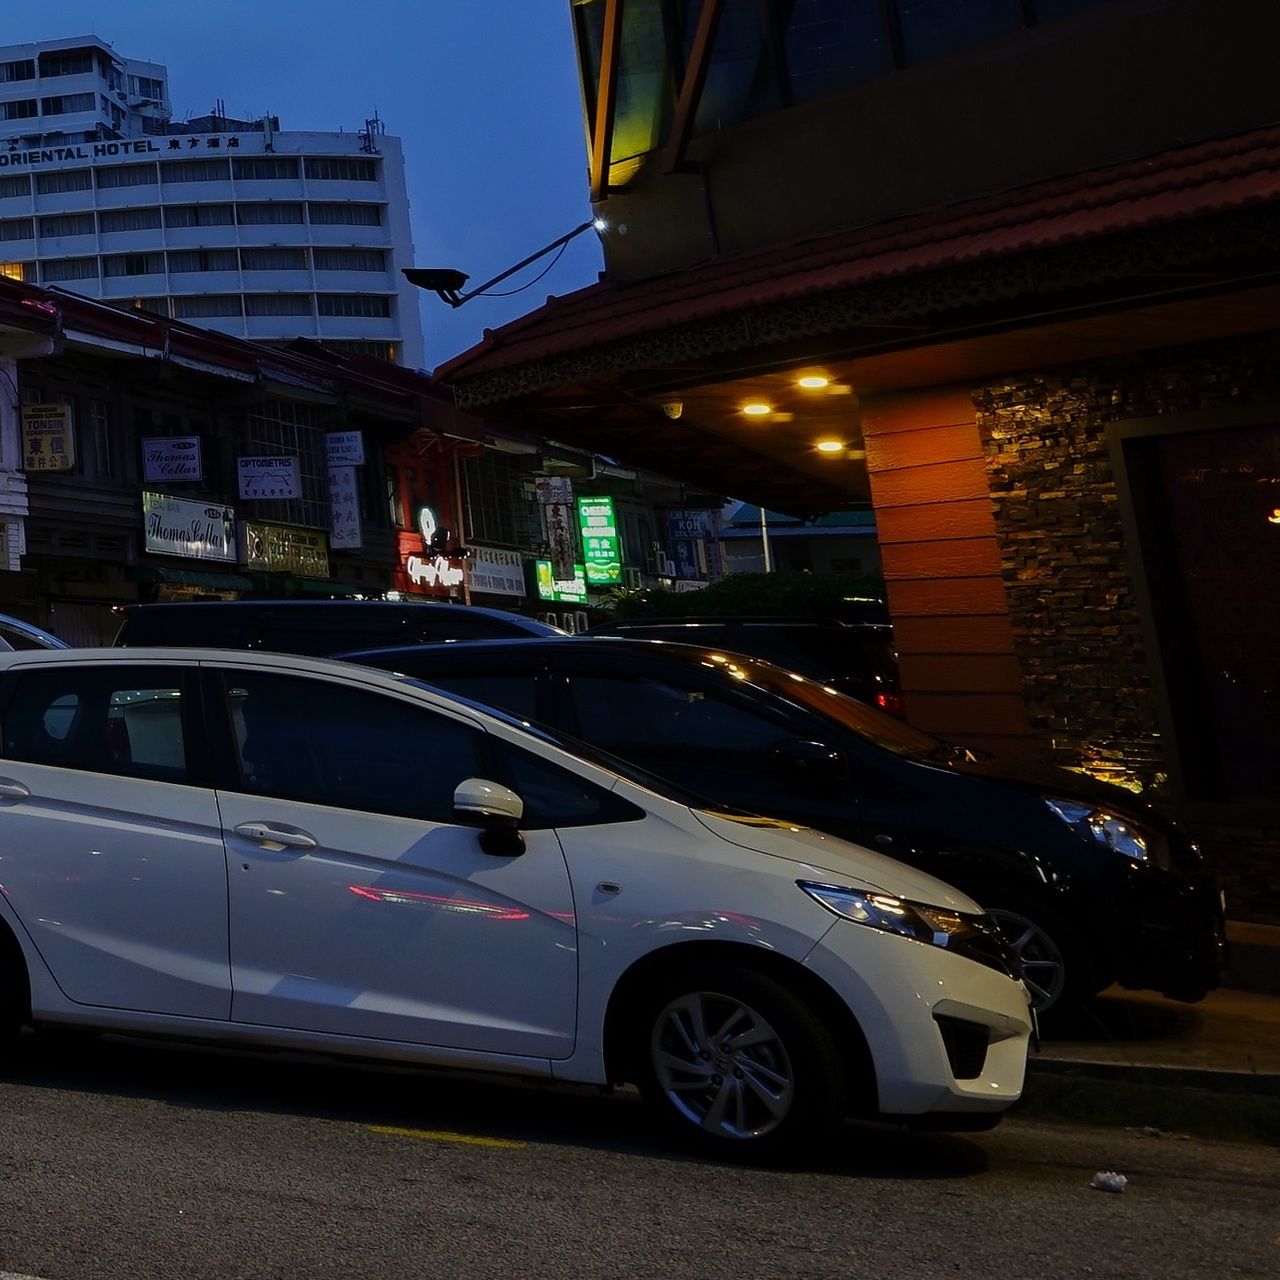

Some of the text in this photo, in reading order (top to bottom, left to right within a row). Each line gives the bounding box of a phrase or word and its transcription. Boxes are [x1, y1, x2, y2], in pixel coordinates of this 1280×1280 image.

[94, 139, 160, 158] HOTEL
[168, 136, 240, 150] 東方酒店
[146, 450, 196, 463] Thomas
[240, 458, 292, 468] OPTOMETRIS
[159, 462, 197, 474] Cellar
[148, 513, 223, 548] Thomas Cellar
